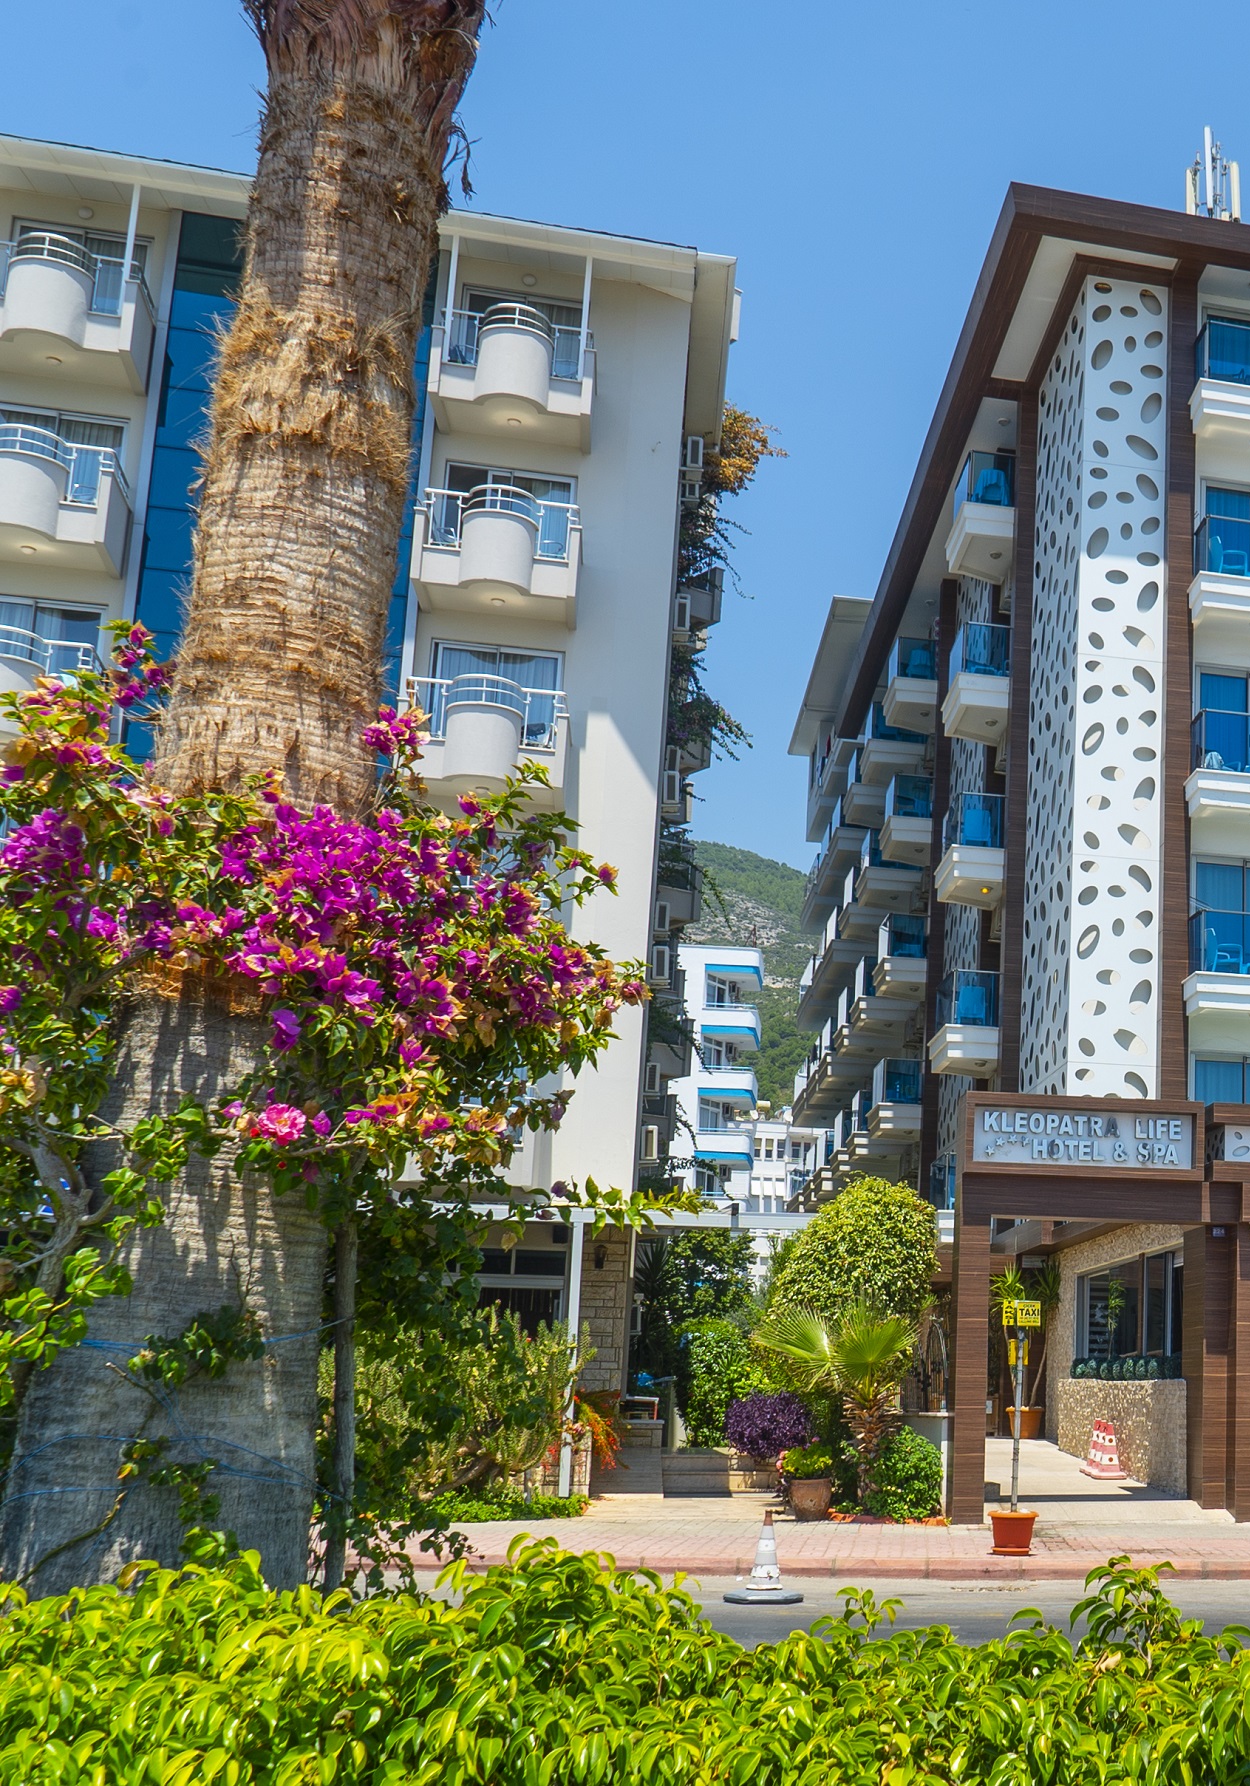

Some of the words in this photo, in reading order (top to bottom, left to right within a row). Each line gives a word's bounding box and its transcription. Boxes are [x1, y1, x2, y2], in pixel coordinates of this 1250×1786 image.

[983, 1110, 1120, 1138] KLEOPATRA
[1134, 1118, 1182, 1141] LIFE
[1031, 1138, 1105, 1161] HOTEL
[1113, 1141, 1129, 1162] &
[1136, 1142, 1179, 1165] SPA
[1019, 1308, 1039, 1317] TAXI
